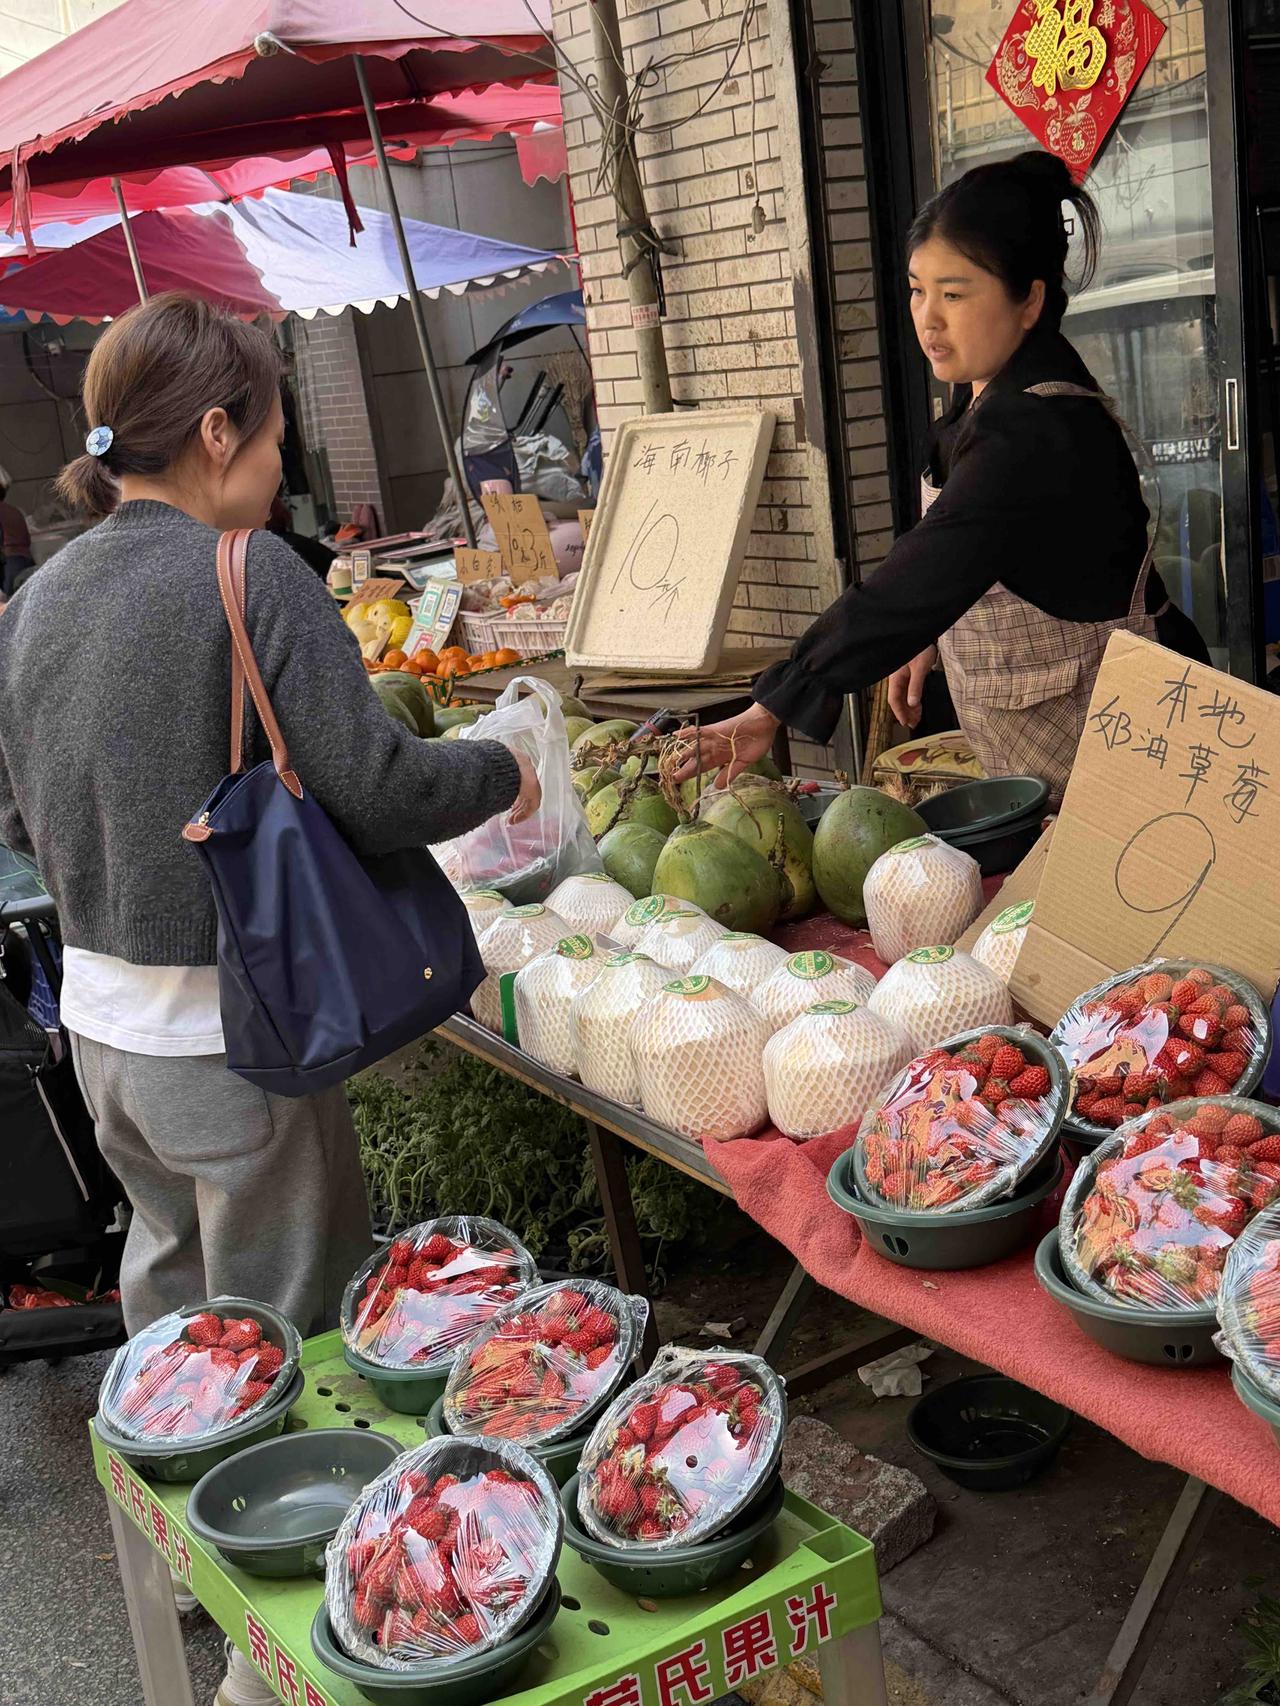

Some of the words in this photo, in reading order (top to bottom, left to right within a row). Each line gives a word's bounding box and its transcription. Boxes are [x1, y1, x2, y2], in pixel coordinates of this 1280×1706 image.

[1025, 0, 1107, 96] 福
[633, 438, 739, 487] 海南椰子
[1157, 664, 1256, 749] 本地
[1089, 695, 1271, 825] 奶油草莓
[107, 1449, 193, 1587] 荣氏果汁
